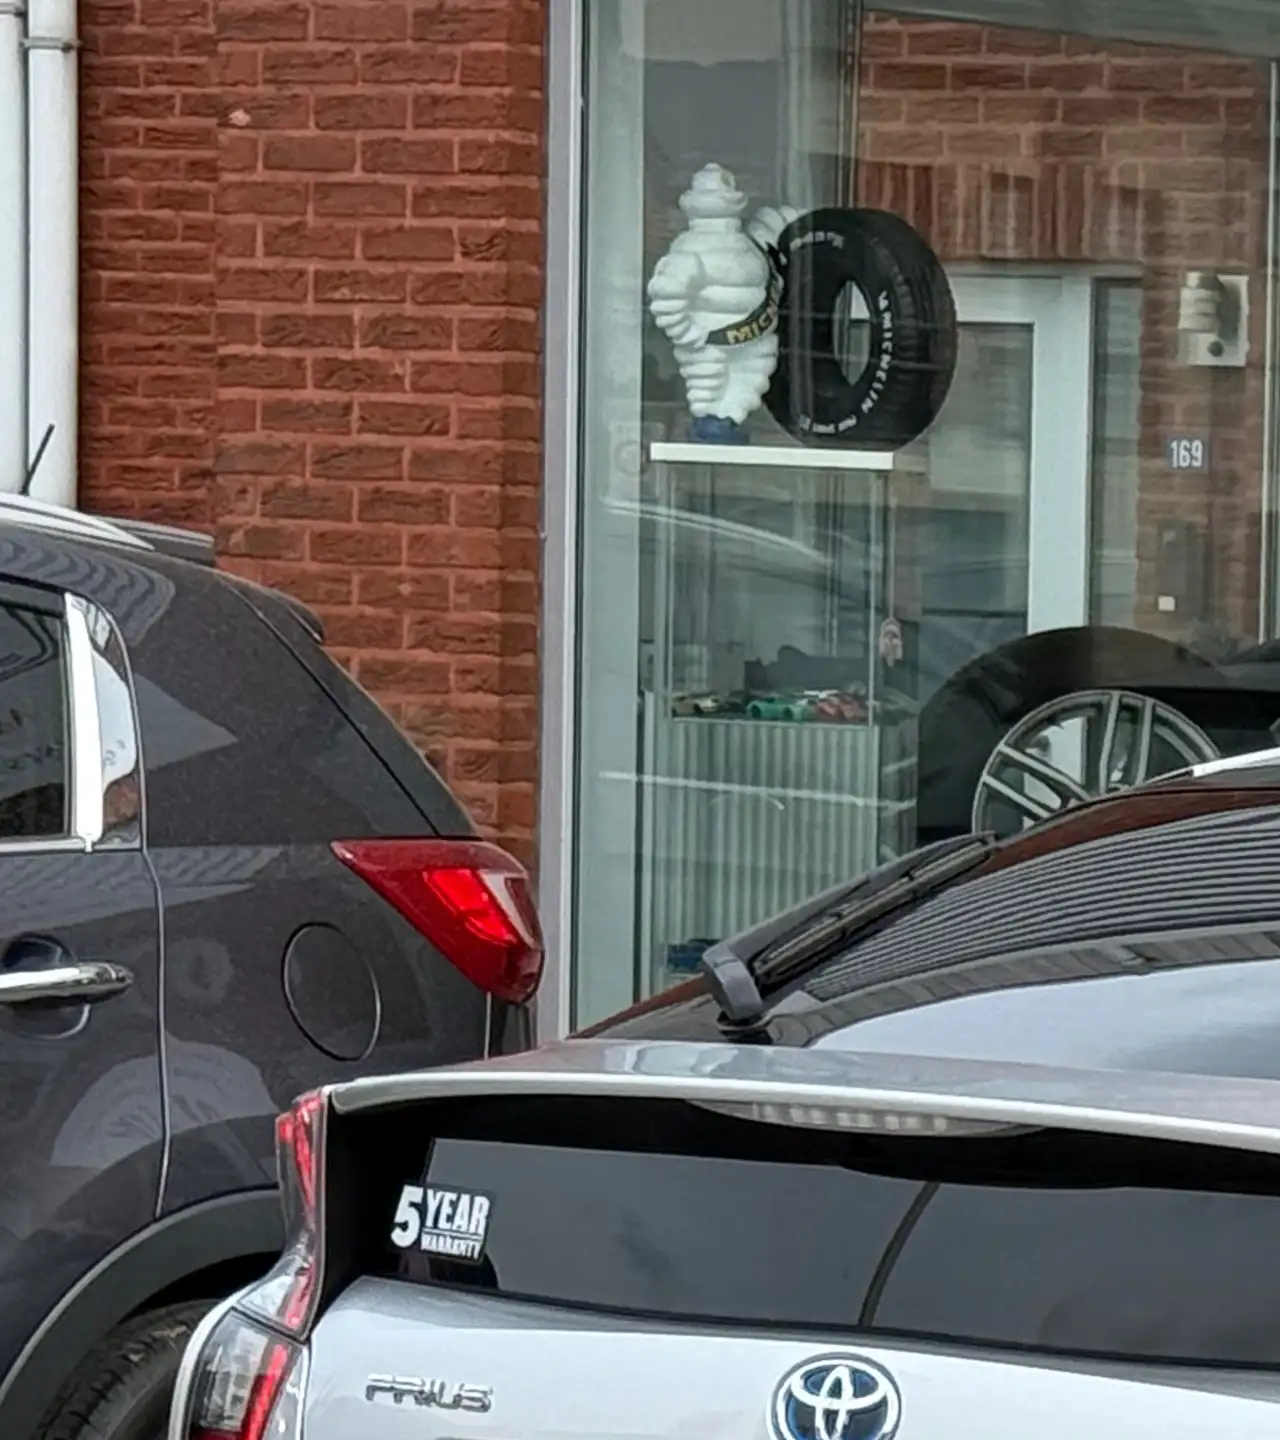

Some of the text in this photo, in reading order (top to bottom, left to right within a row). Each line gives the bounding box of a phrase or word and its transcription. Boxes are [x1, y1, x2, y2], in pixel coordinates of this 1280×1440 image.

[1171, 439, 1203, 468] 169
[391, 1184, 491, 1248] 5 YEAR
[420, 1233, 481, 1260] WARRANTY
[364, 1373, 494, 1413] PRIUS
